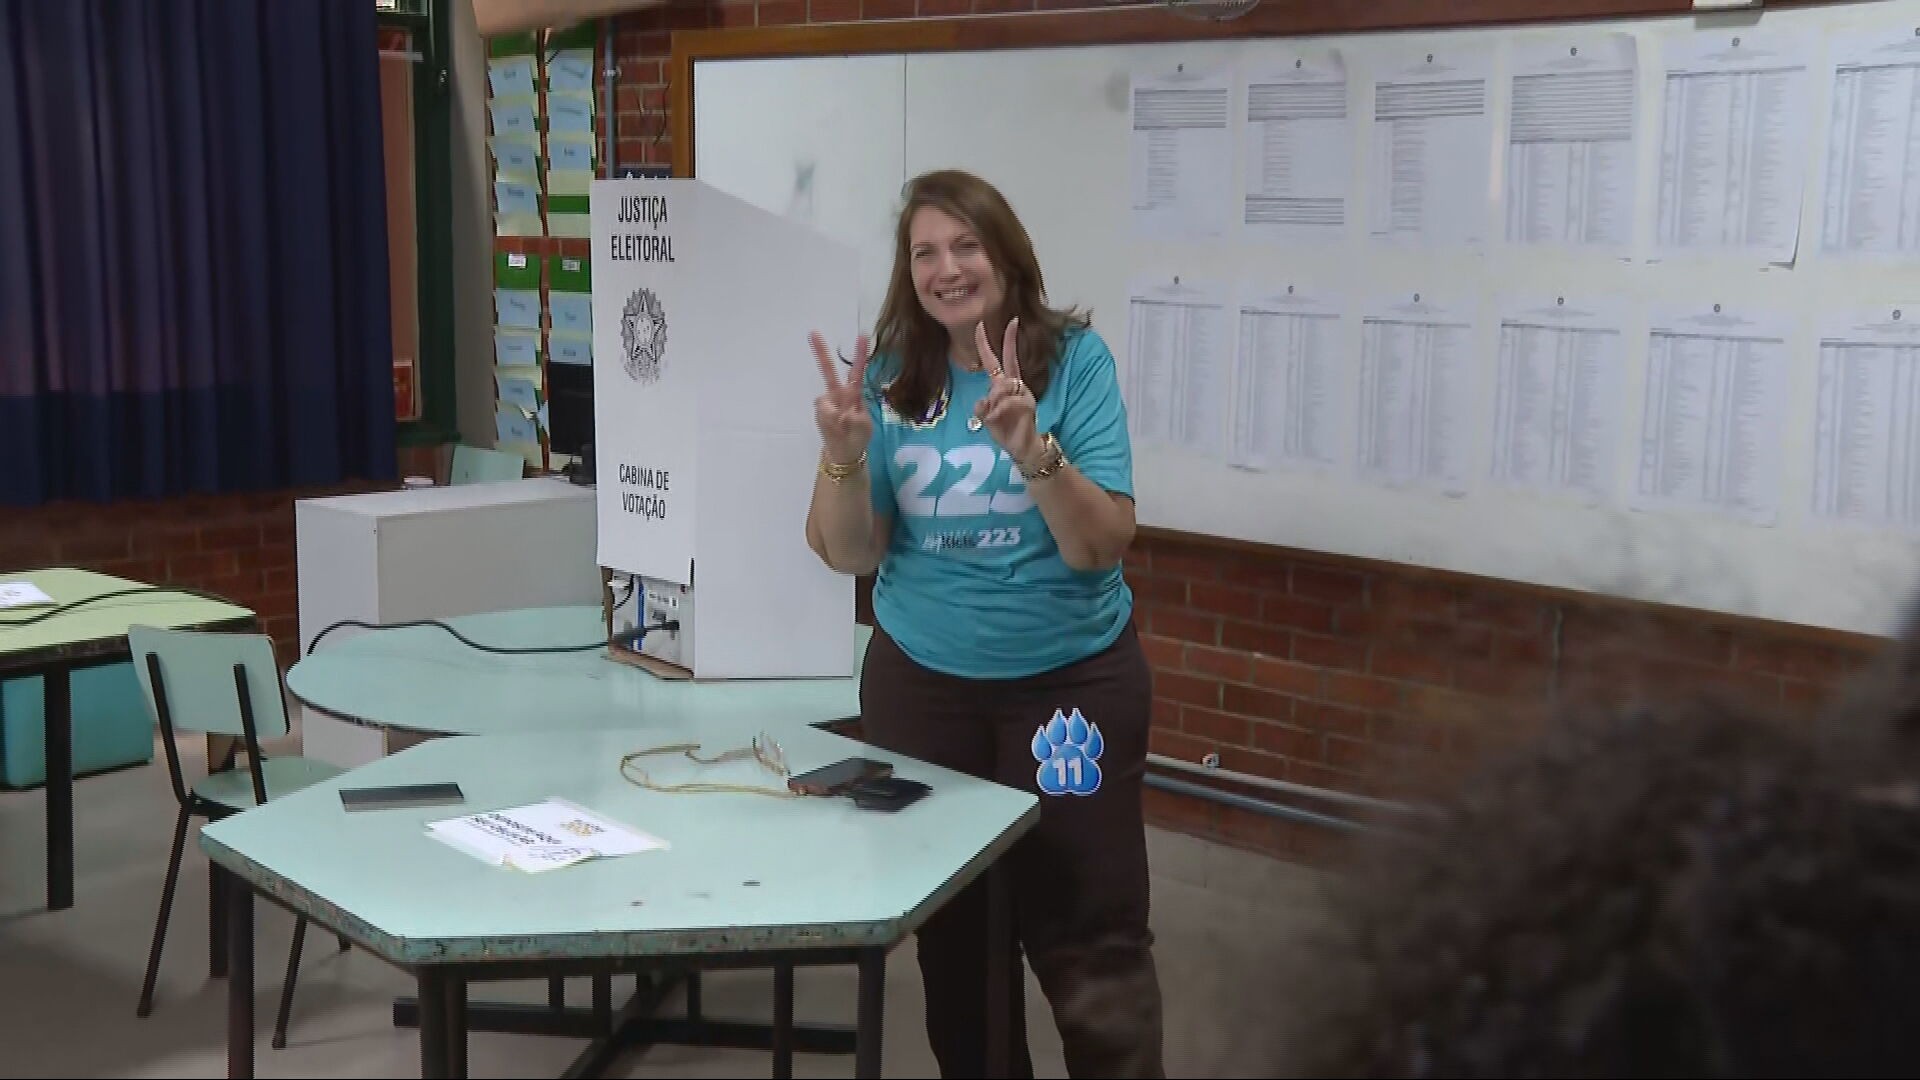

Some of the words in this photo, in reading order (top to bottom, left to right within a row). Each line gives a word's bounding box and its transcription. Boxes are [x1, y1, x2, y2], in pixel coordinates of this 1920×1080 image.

[618, 195, 668, 230] JUSTIÇA
[611, 234, 675, 262] ELEITORAL
[619, 463, 654, 488] CABINA
[656, 469, 670, 490] DE
[622, 491, 666, 521] VOTAÇÃO
[976, 526, 1021, 548] 223
[1052, 757, 1083, 787] 11
